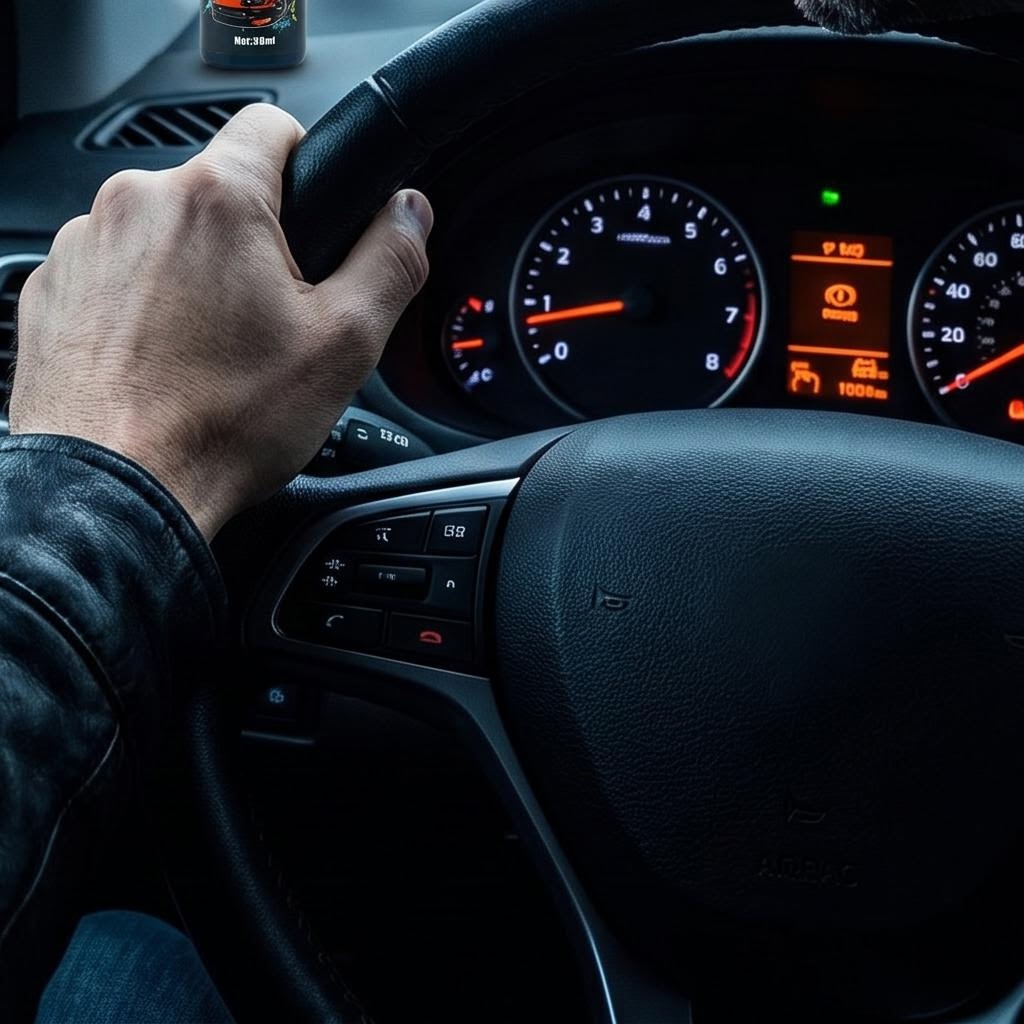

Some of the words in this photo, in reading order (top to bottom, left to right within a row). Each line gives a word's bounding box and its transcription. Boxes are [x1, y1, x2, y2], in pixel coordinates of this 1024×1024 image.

[591, 217, 604, 234] 3
[684, 222, 697, 239] 5
[557, 248, 570, 265] 2
[973, 252, 998, 268] 60
[713, 258, 727, 275] 6
[945, 283, 971, 299] 40
[543, 294, 551, 312] 1
[725, 306, 739, 324] 7
[941, 327, 965, 343] 20
[554, 342, 569, 360] 0
[705, 353, 720, 371] 8
